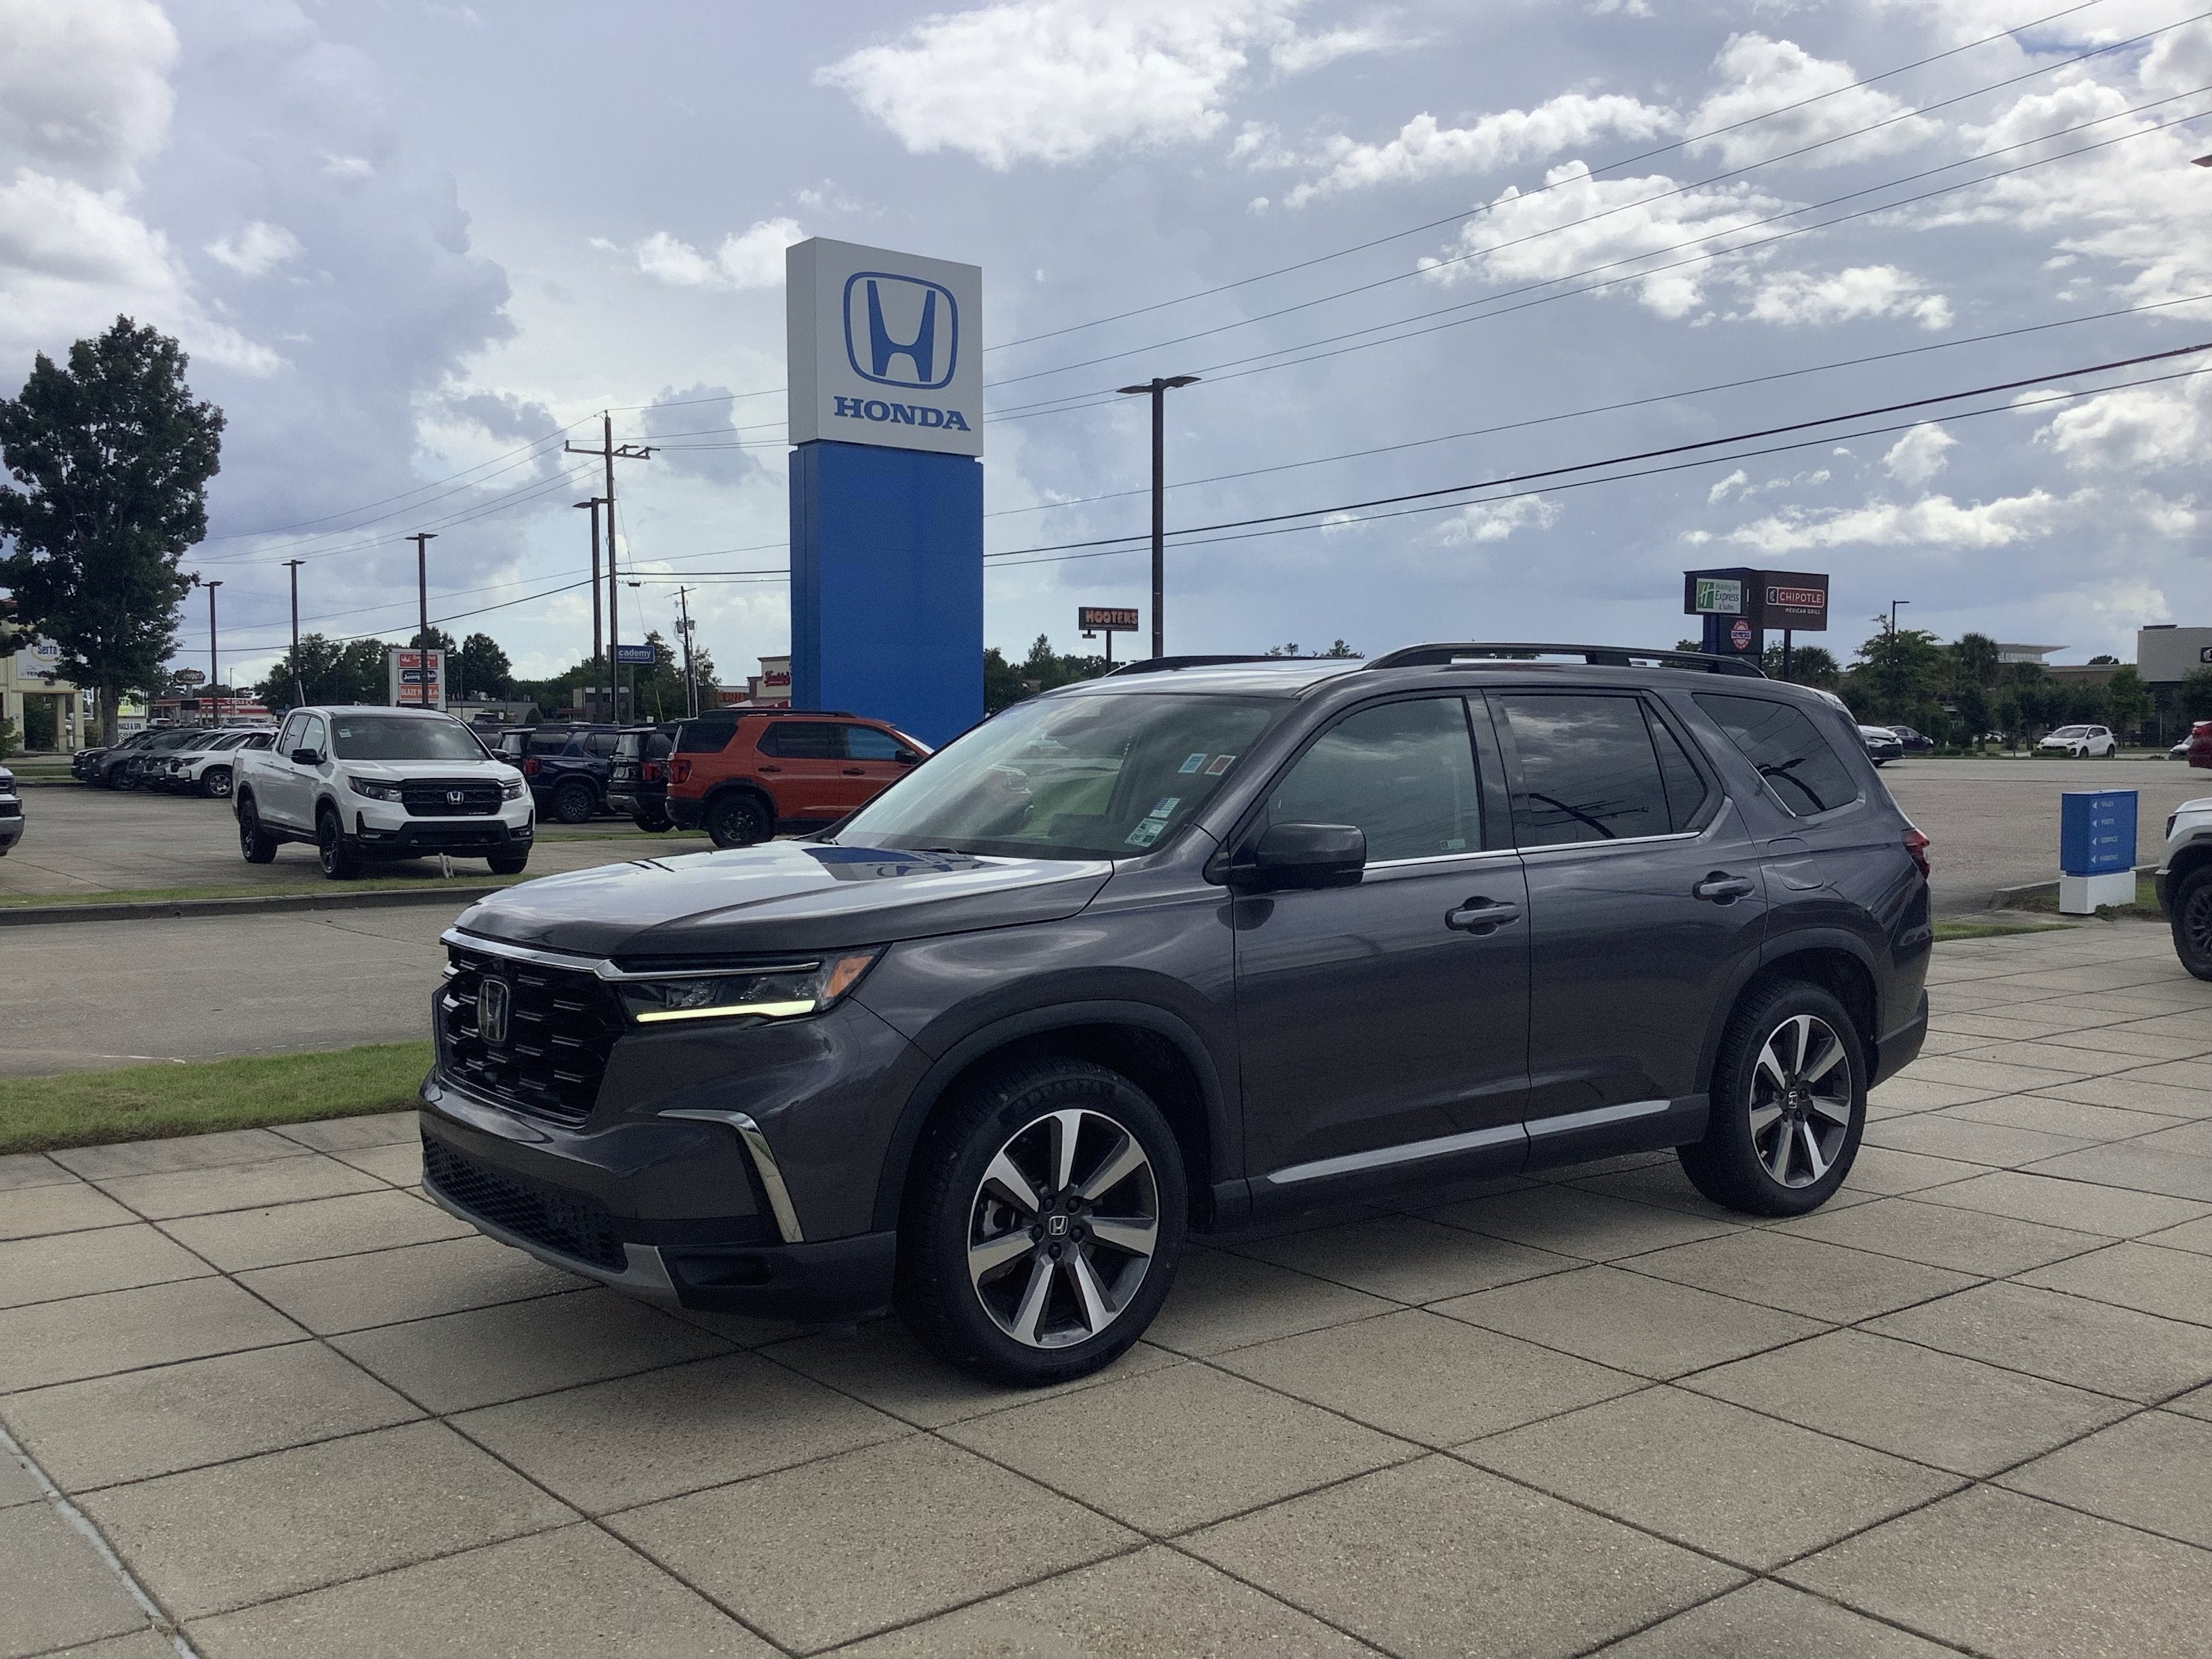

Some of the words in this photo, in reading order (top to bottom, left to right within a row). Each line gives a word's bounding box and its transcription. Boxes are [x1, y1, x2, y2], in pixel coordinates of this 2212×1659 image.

[834, 396, 971, 432] HONDA
[1715, 590, 1739, 602] Express
[1780, 592, 1822, 603] CHIPOTLE
[1086, 610, 1138, 624] HOOTERS
[37, 644, 58, 655] Serta
[618, 649, 651, 659] cademy
[725, 693, 744, 702] PIZZA
